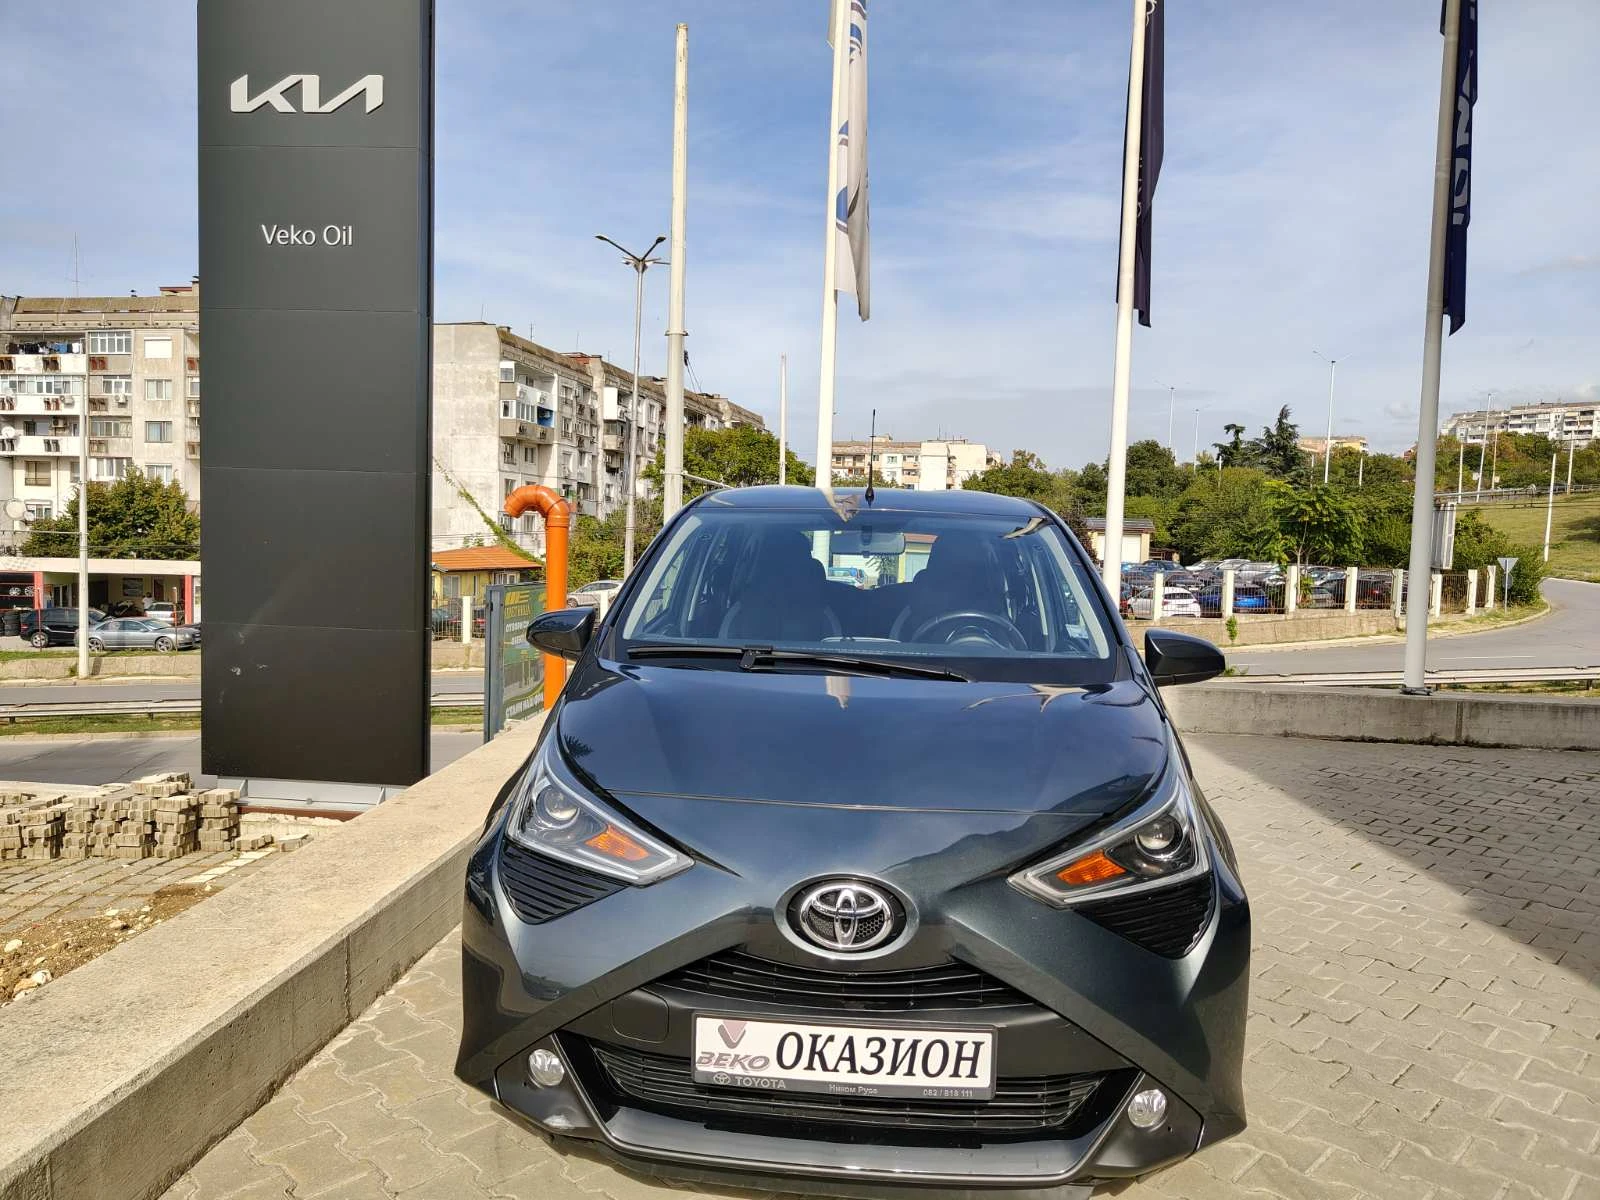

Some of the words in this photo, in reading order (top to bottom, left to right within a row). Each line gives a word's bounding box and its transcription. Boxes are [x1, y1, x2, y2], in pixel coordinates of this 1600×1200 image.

[261, 224, 316, 245] Veko
[323, 225, 353, 245] Oil
[776, 1031, 985, 1079] ОКАЗИОН
[734, 1076, 786, 1089] TOYOTA
